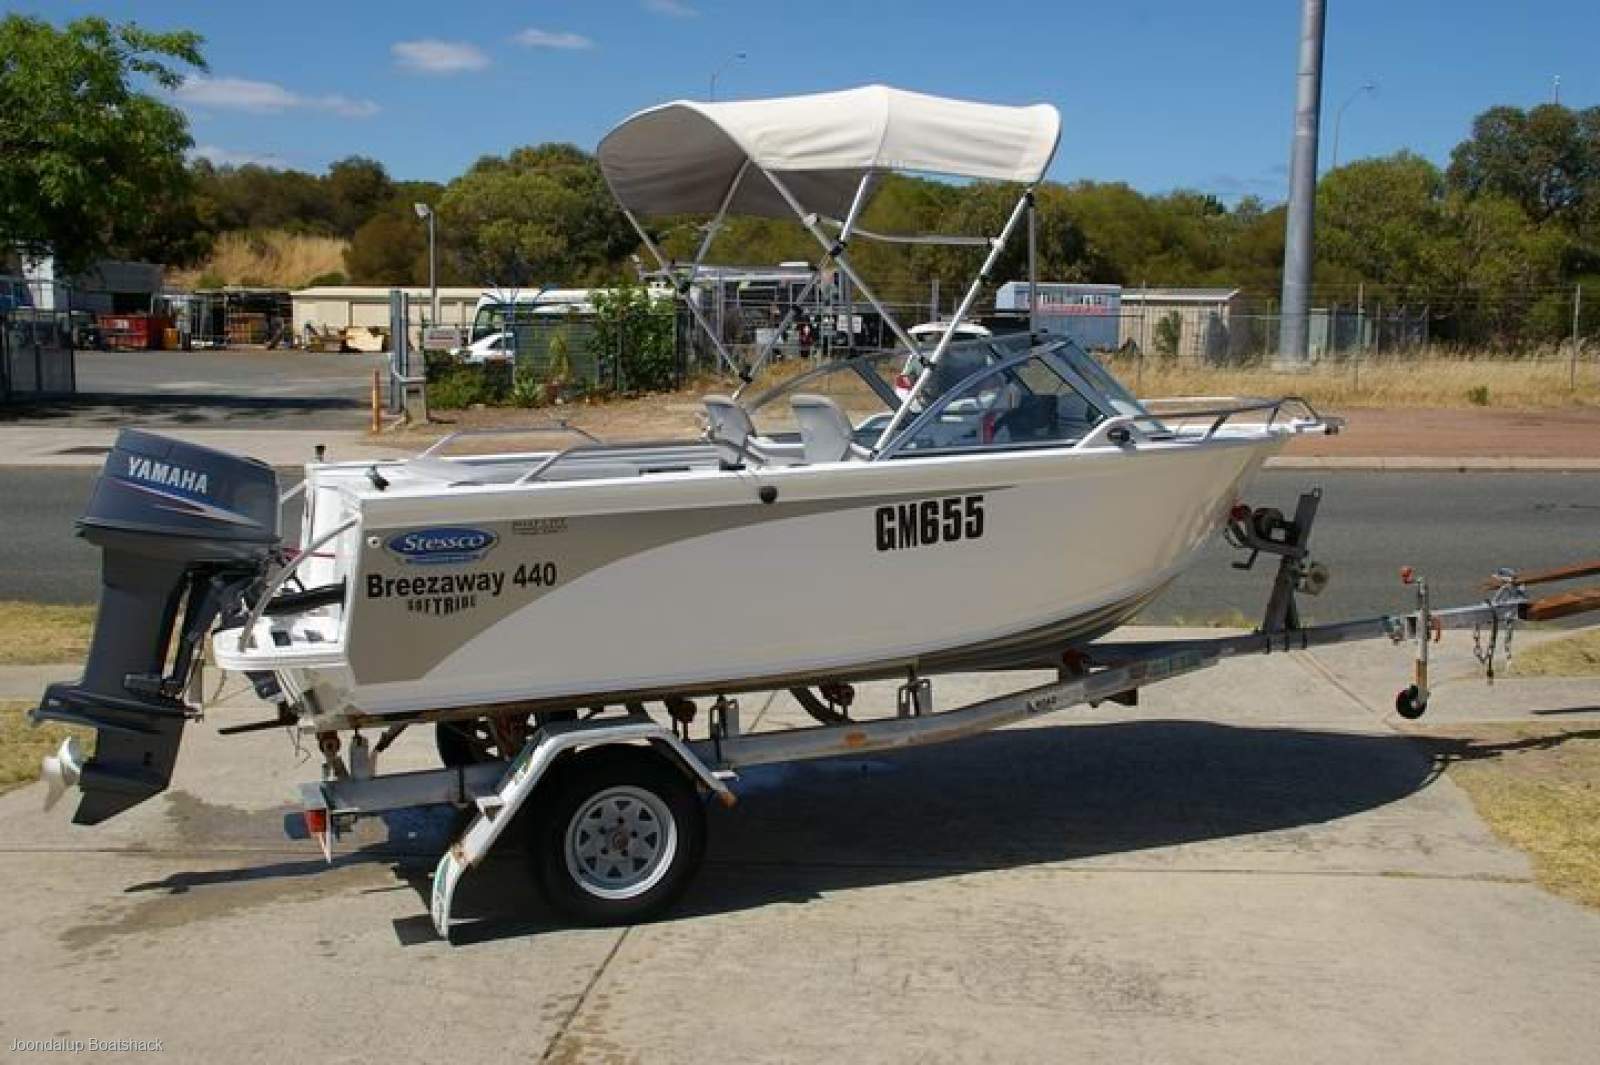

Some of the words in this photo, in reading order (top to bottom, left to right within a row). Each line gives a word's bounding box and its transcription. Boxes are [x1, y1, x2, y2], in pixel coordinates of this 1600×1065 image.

[128, 456, 208, 494] YAMAHA
[403, 533, 485, 551] Stessco
[876, 495, 984, 551] GM655
[367, 571, 504, 599] Breezaway
[513, 561, 557, 588] 440
